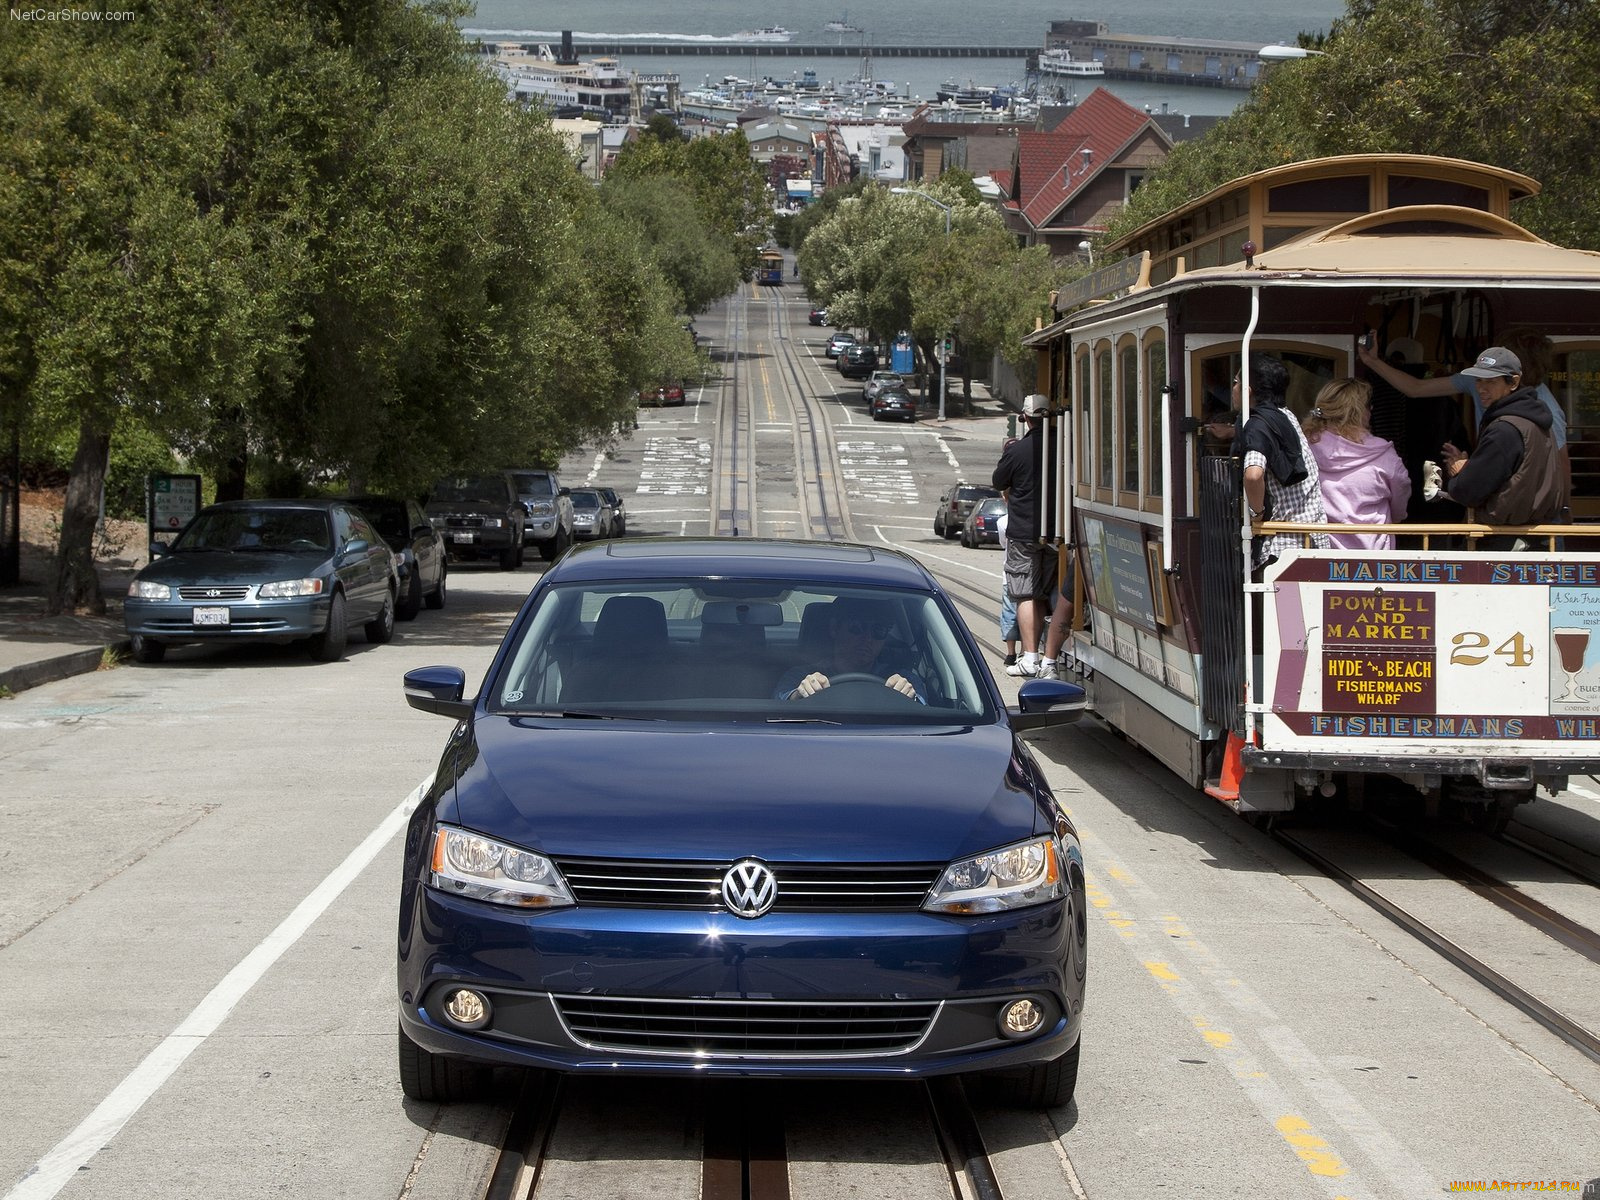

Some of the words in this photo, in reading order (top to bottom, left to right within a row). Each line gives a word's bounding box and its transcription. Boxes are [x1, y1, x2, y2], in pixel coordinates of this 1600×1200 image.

[158, 480, 168, 491] 2
[1329, 562, 1463, 581] MARKET
[1491, 563, 1597, 583] STREE
[1329, 596, 1429, 612] POWELL
[1356, 613, 1406, 624] AND
[1327, 624, 1432, 640] MARKET
[1450, 631, 1534, 667] 24
[1328, 660, 1363, 676] HYDE
[1367, 661, 1384, 677] AND
[1386, 661, 1432, 678] BEACH
[1337, 680, 1422, 693] FISHERMANS
[1357, 693, 1401, 705] WHARF
[1312, 715, 1524, 737] FISHERMANS
[1556, 719, 1599, 738] WH
